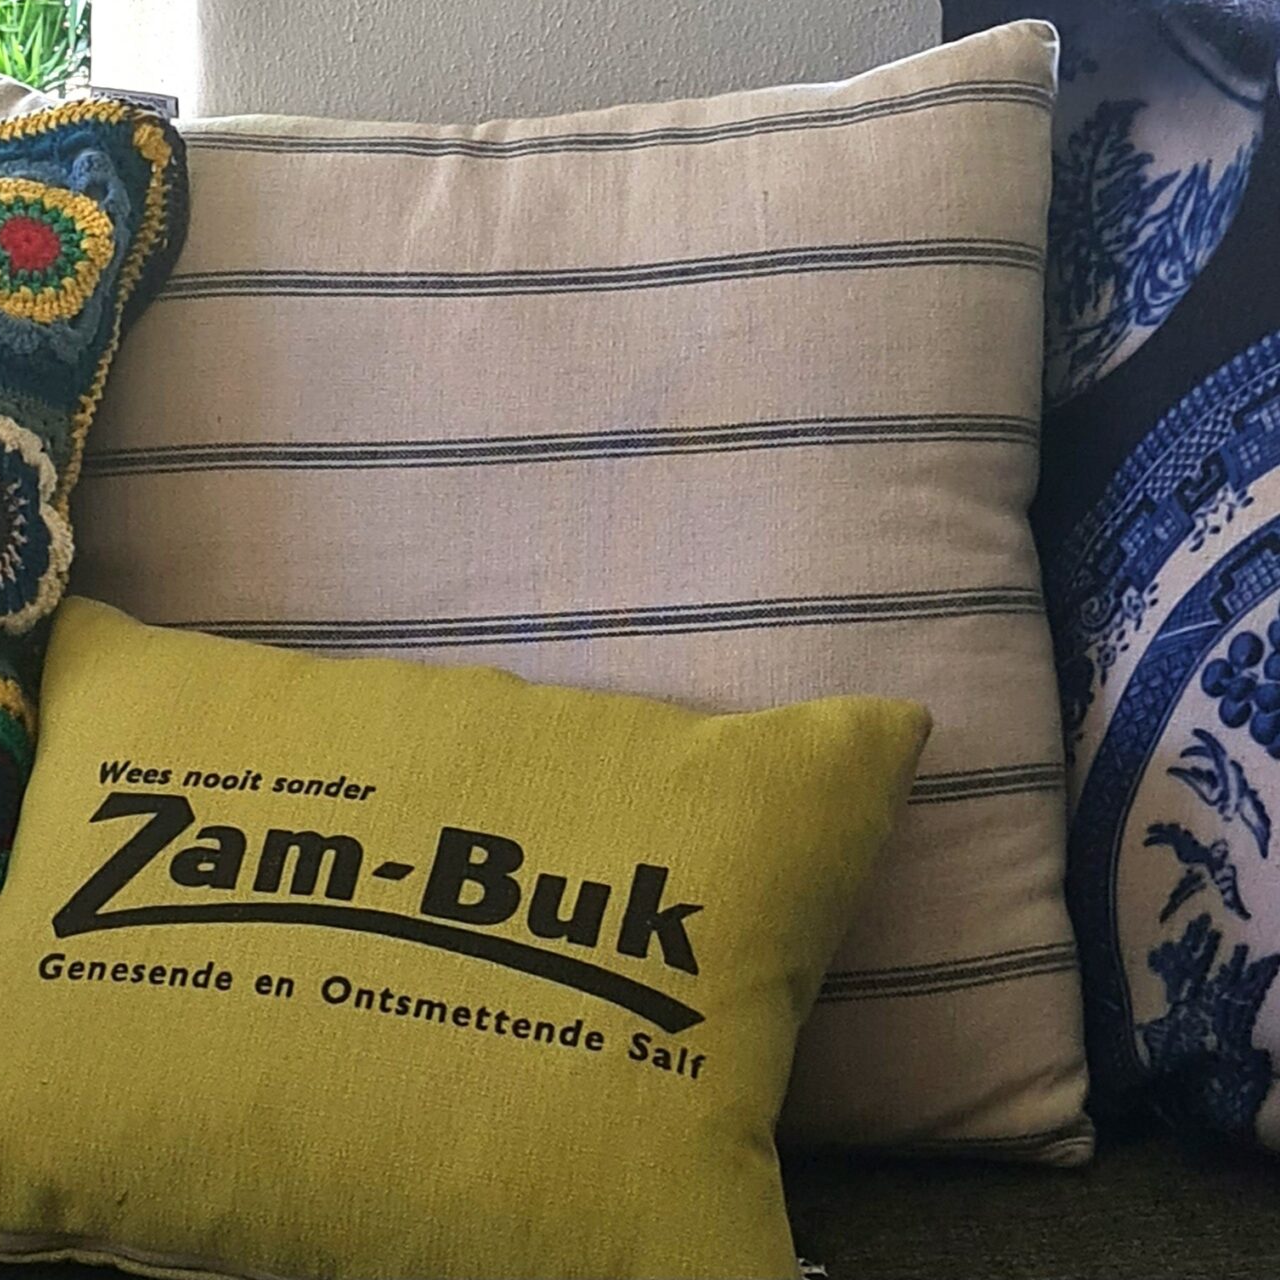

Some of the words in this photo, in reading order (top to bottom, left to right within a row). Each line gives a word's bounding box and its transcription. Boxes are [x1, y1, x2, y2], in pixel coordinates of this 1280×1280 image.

[100, 760, 173, 785] Wees
[182, 769, 263, 791] nooit
[272, 775, 377, 801] sonder
[52, 792, 706, 1035] Zam-Buk
[38, 952, 233, 991] Genesende
[254, 974, 295, 999] en
[321, 975, 605, 1052] Ontsmettende
[627, 1032, 708, 1081] Salf
